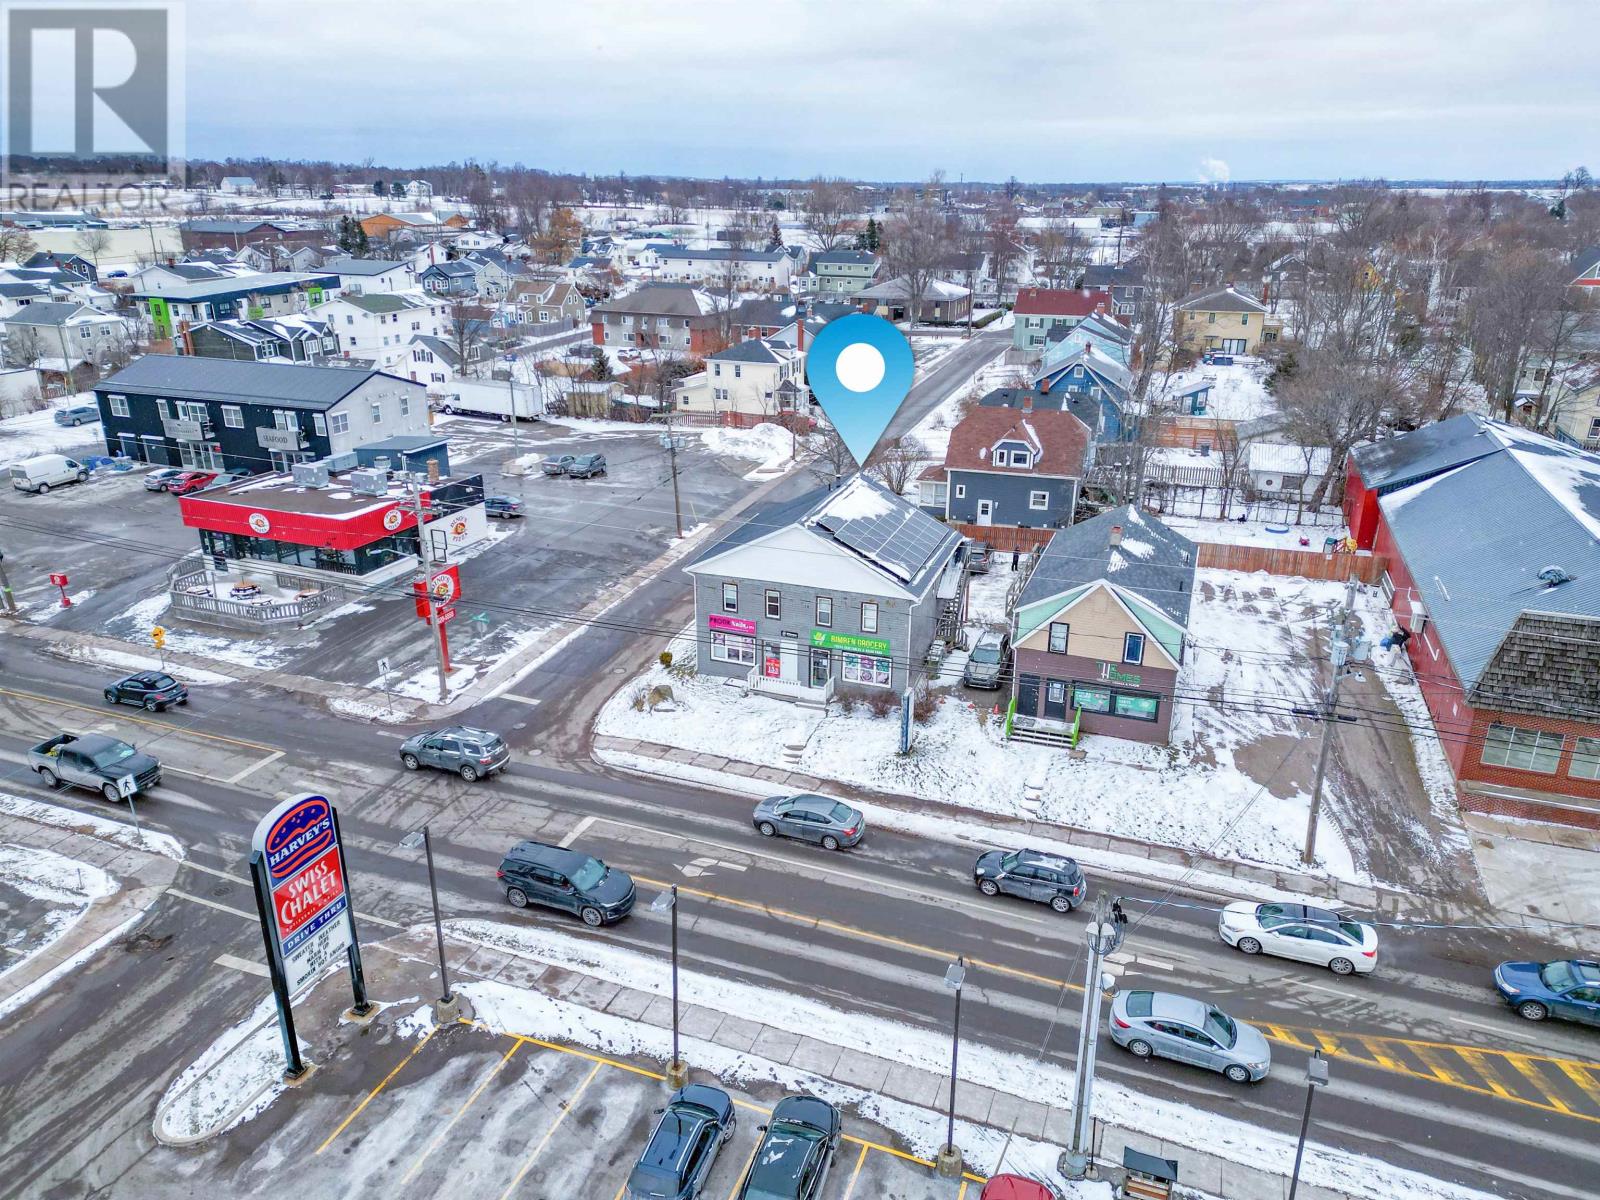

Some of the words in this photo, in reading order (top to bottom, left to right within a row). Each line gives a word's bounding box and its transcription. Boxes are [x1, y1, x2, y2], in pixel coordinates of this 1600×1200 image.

[262, 434, 288, 445] SEAFOOD
[857, 639, 887, 651] GROCERY
[269, 818, 330, 867] HARVEY'S
[281, 869, 336, 924] CHALET
[288, 860, 328, 899] SWISS
[287, 922, 316, 949] DRIVE
[318, 901, 342, 923] THRU
[292, 942, 314, 962] SWEATER
[318, 920, 341, 940] WEATHER
[296, 967, 316, 986] SMOKIN
